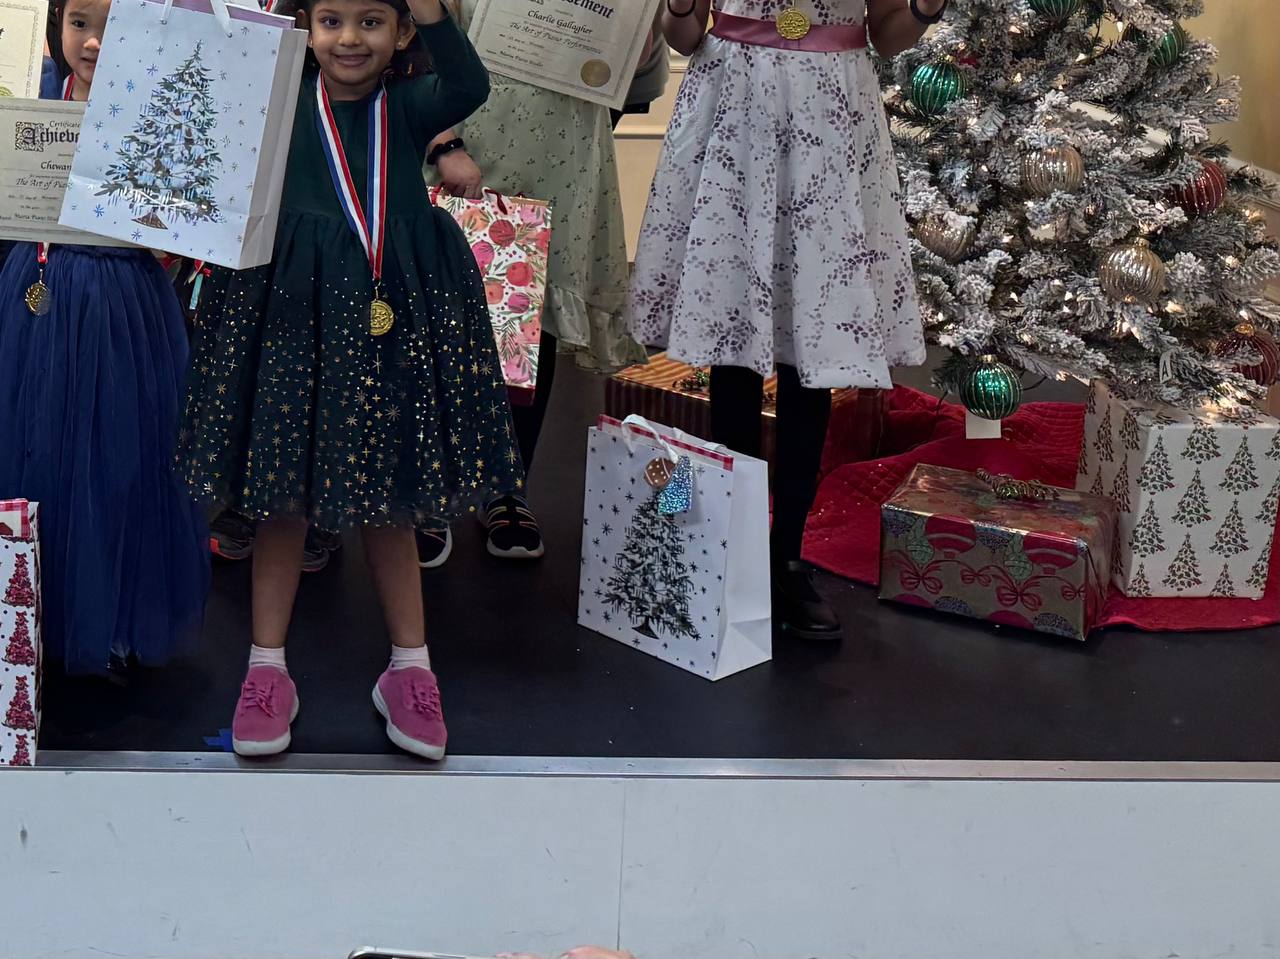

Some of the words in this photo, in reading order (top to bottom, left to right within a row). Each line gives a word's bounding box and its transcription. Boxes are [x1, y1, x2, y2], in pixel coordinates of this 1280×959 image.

[527, 9, 556, 24] Charlie
[556, 19, 593, 34] Gallagher
[16, 178, 29, 186] The
[30, 179, 43, 187] Art
[43, 180, 52, 191] of
